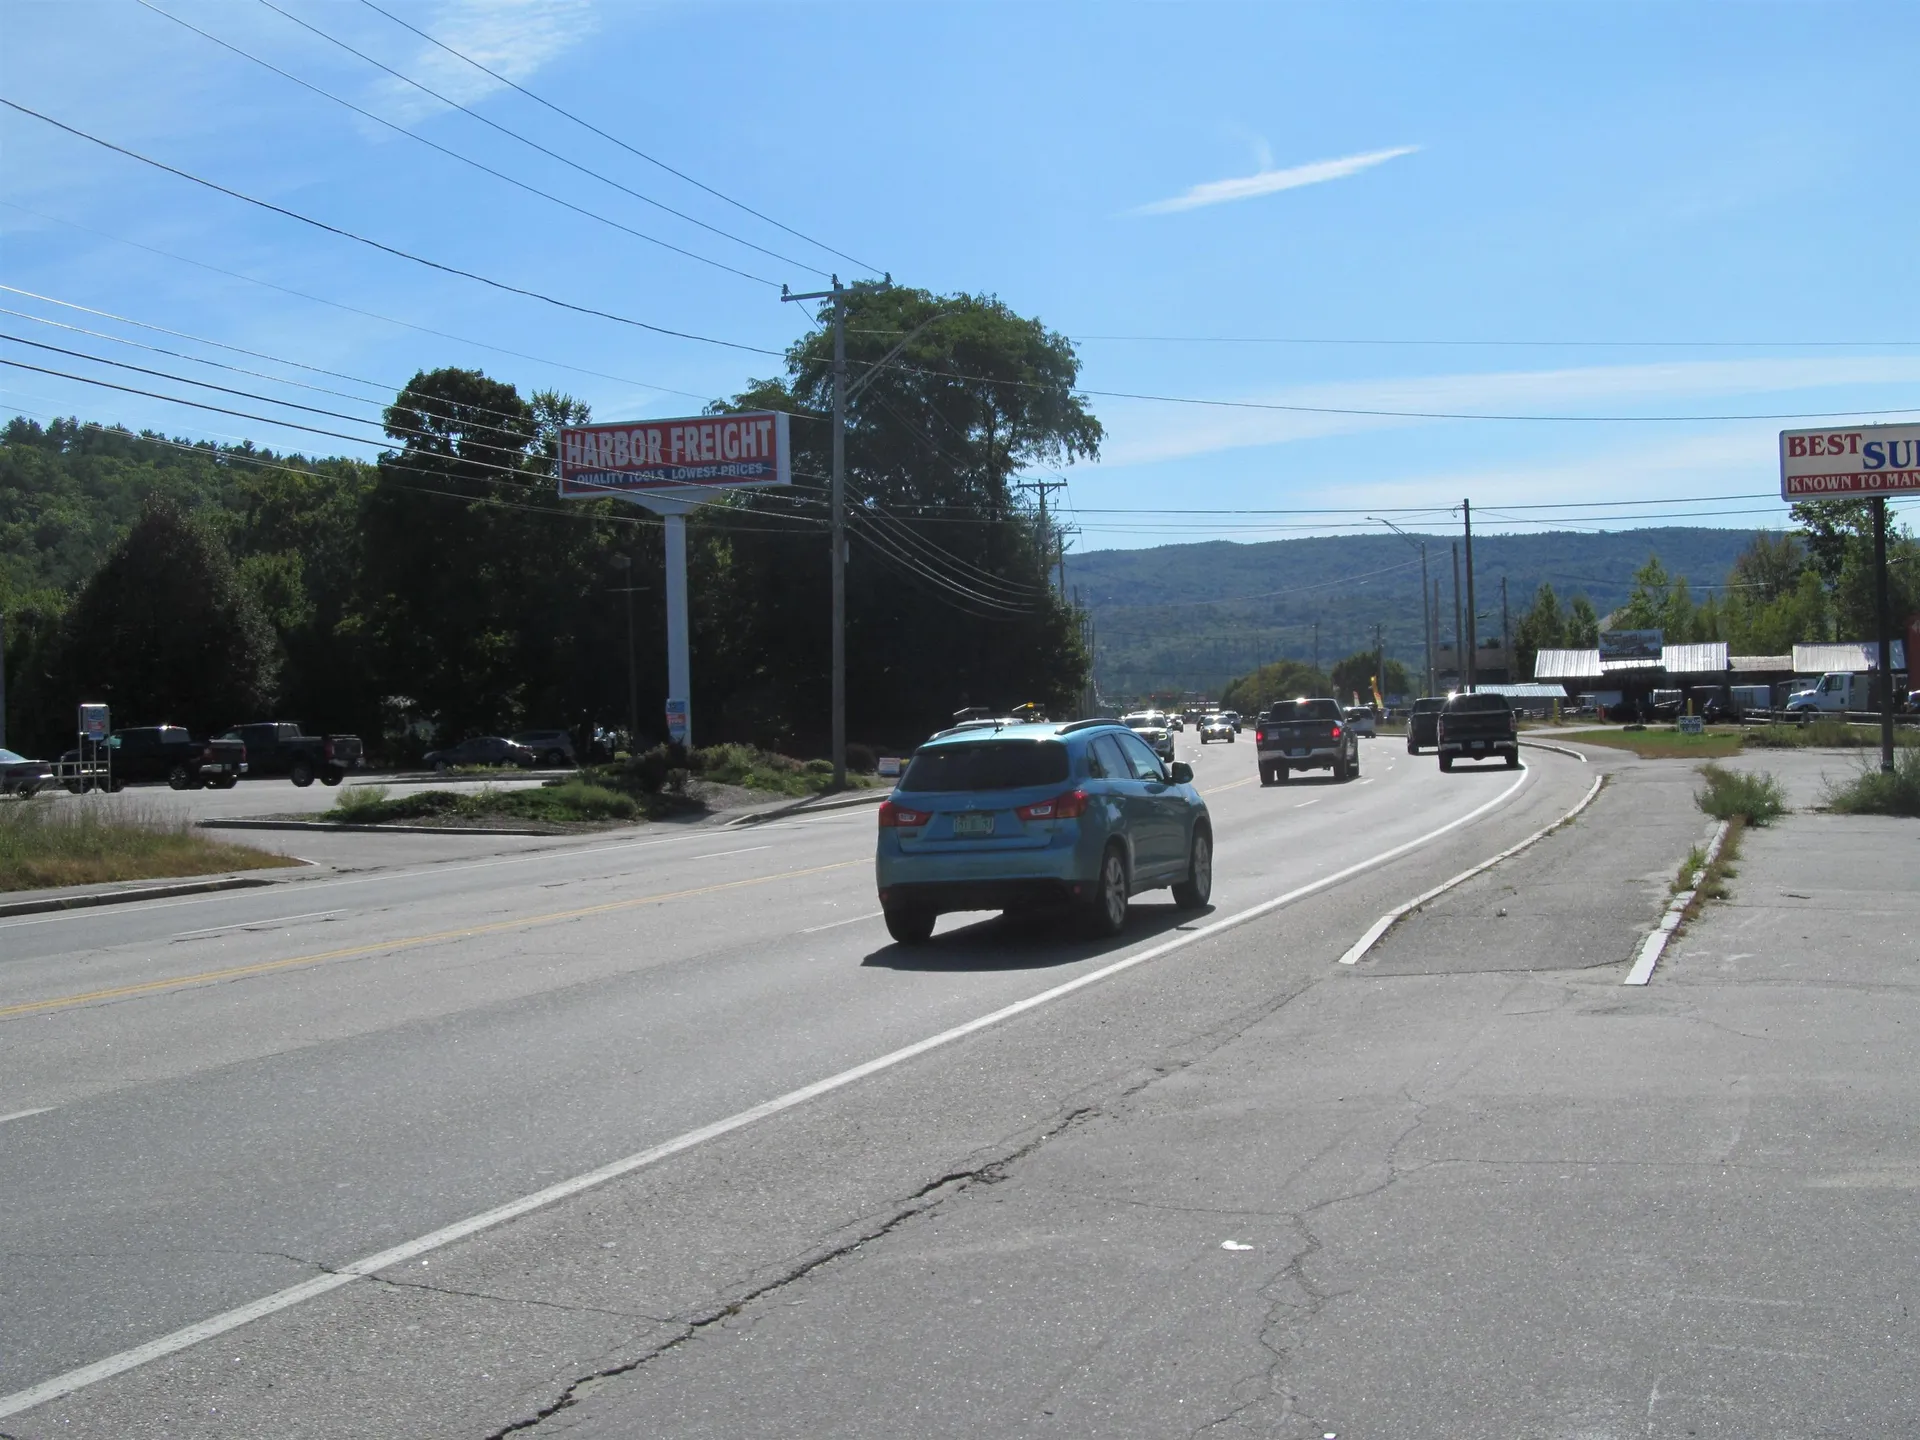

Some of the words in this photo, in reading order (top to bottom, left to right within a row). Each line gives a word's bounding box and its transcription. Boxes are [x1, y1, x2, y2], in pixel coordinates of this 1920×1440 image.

[565, 428, 663, 470] HARBOR
[669, 420, 772, 464] FREIGHT
[1788, 433, 1863, 458] BEST
[1862, 440, 1920, 470] SU
[577, 472, 624, 486] QUALITY
[629, 469, 665, 482] TOOLS
[672, 466, 718, 480] LOWEST
[720, 462, 763, 476] PRICES
[1790, 475, 1852, 492] KNOWN
[1857, 474, 1881, 488] TO
